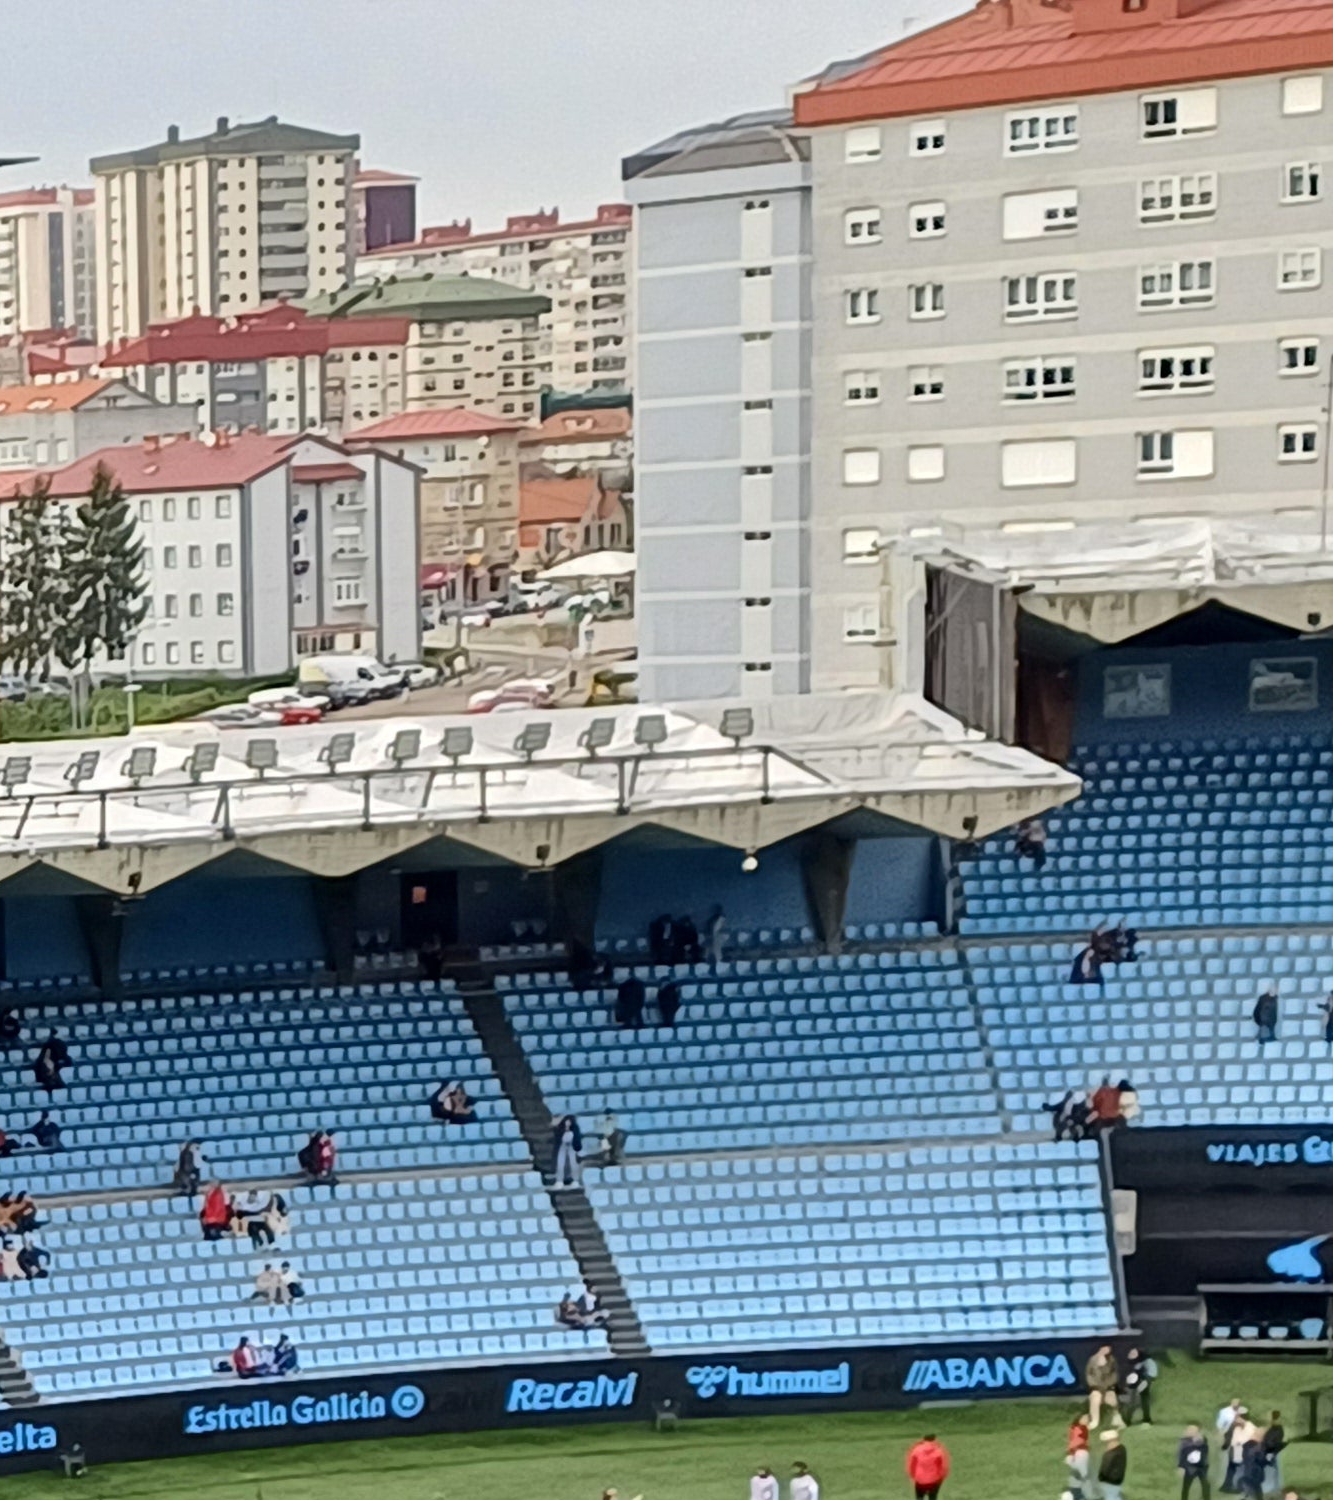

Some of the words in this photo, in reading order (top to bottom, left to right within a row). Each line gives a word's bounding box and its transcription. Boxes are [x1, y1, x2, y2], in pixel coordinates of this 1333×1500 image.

[1206, 1143, 1298, 1167] VIAJES
[726, 1362, 849, 1394] hummel
[904, 1354, 1075, 1391] ABANCA
[506, 1373, 638, 1413] Recalvi
[184, 1400, 287, 1434] Estrella
[291, 1391, 385, 1424] Galicia
